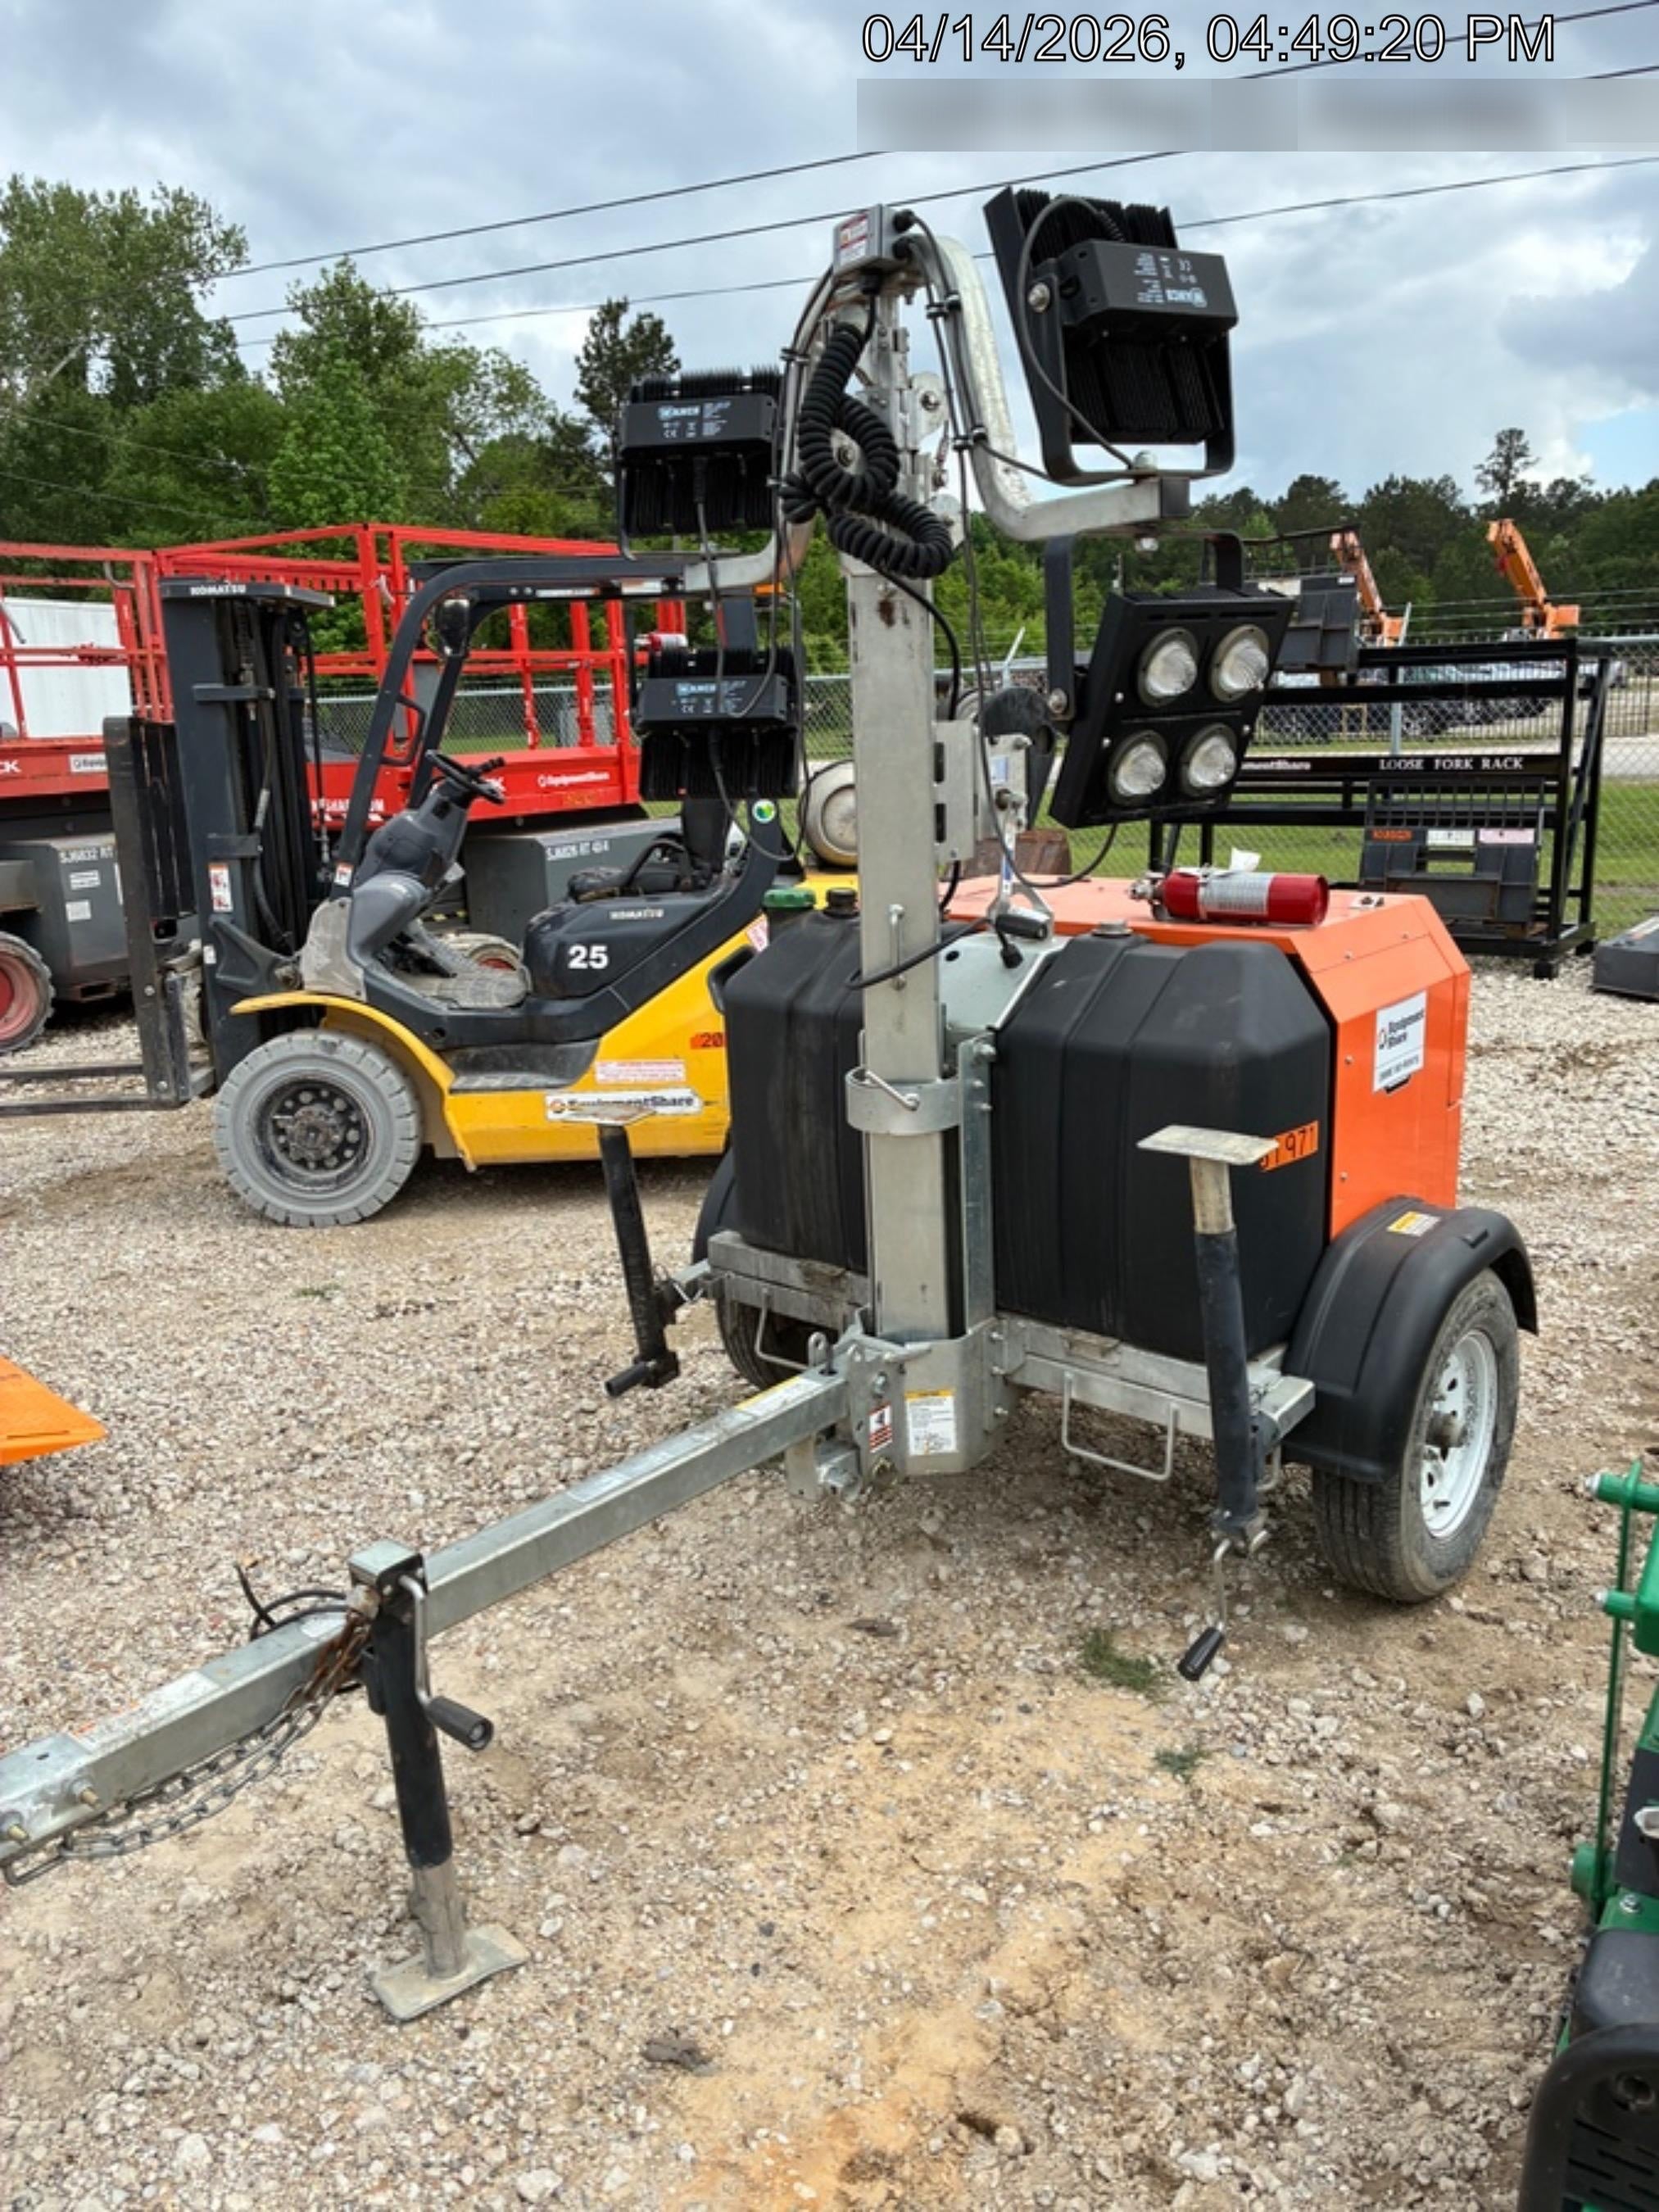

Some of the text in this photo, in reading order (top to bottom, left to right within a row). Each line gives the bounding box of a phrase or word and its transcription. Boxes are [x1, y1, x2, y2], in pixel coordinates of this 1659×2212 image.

[190, 584, 246, 596] KOMATSU
[1379, 757, 1523, 770] LOOSE FORK RACK
[568, 945, 609, 969] 25
